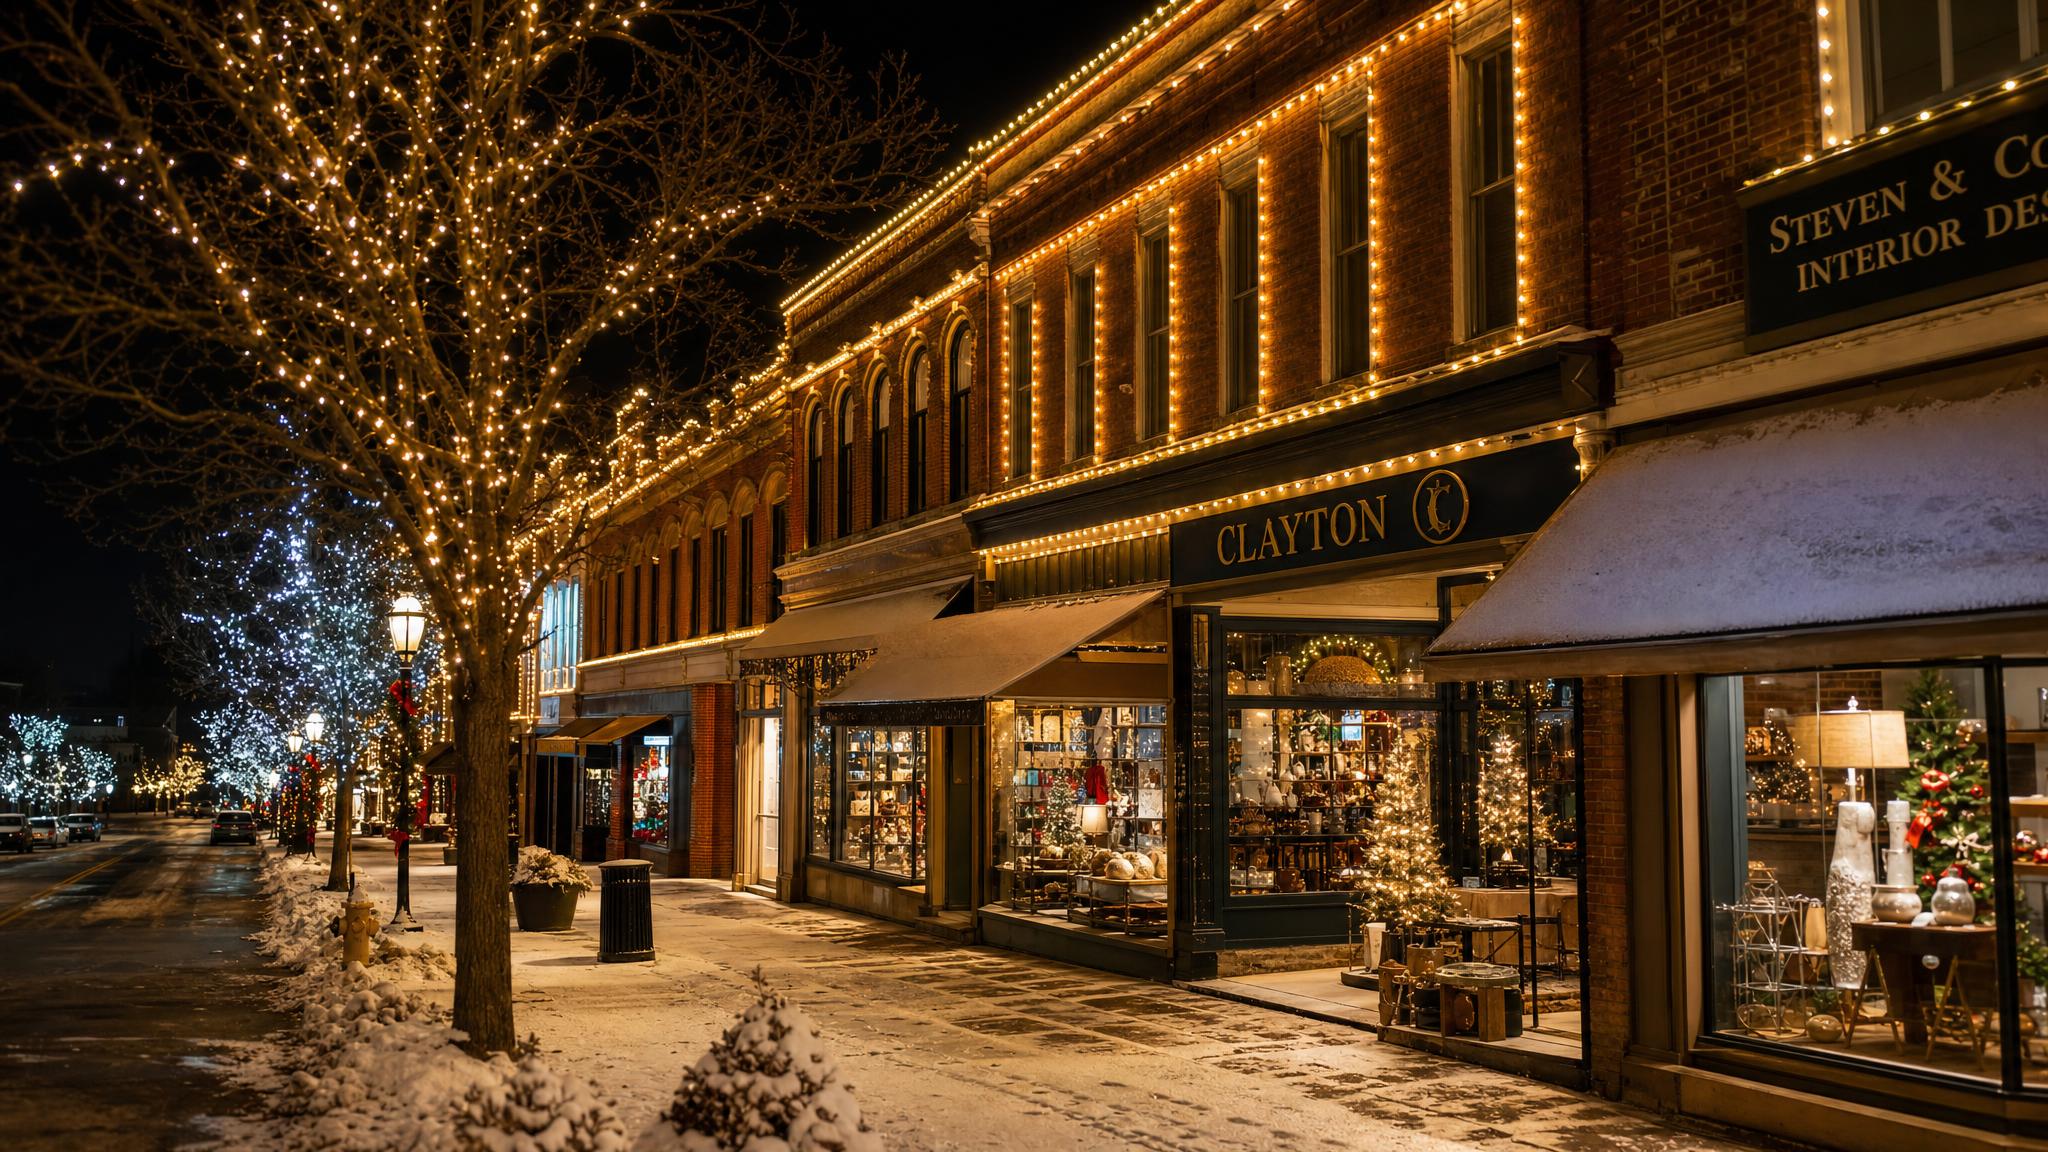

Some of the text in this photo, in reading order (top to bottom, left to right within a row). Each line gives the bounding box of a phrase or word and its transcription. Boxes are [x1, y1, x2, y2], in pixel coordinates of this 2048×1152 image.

[1769, 180, 1908, 255] STEVEN
[1929, 159, 1968, 202] &
[1796, 217, 1967, 293] INTERIOR
[1216, 494, 1388, 567] CLAYTON
